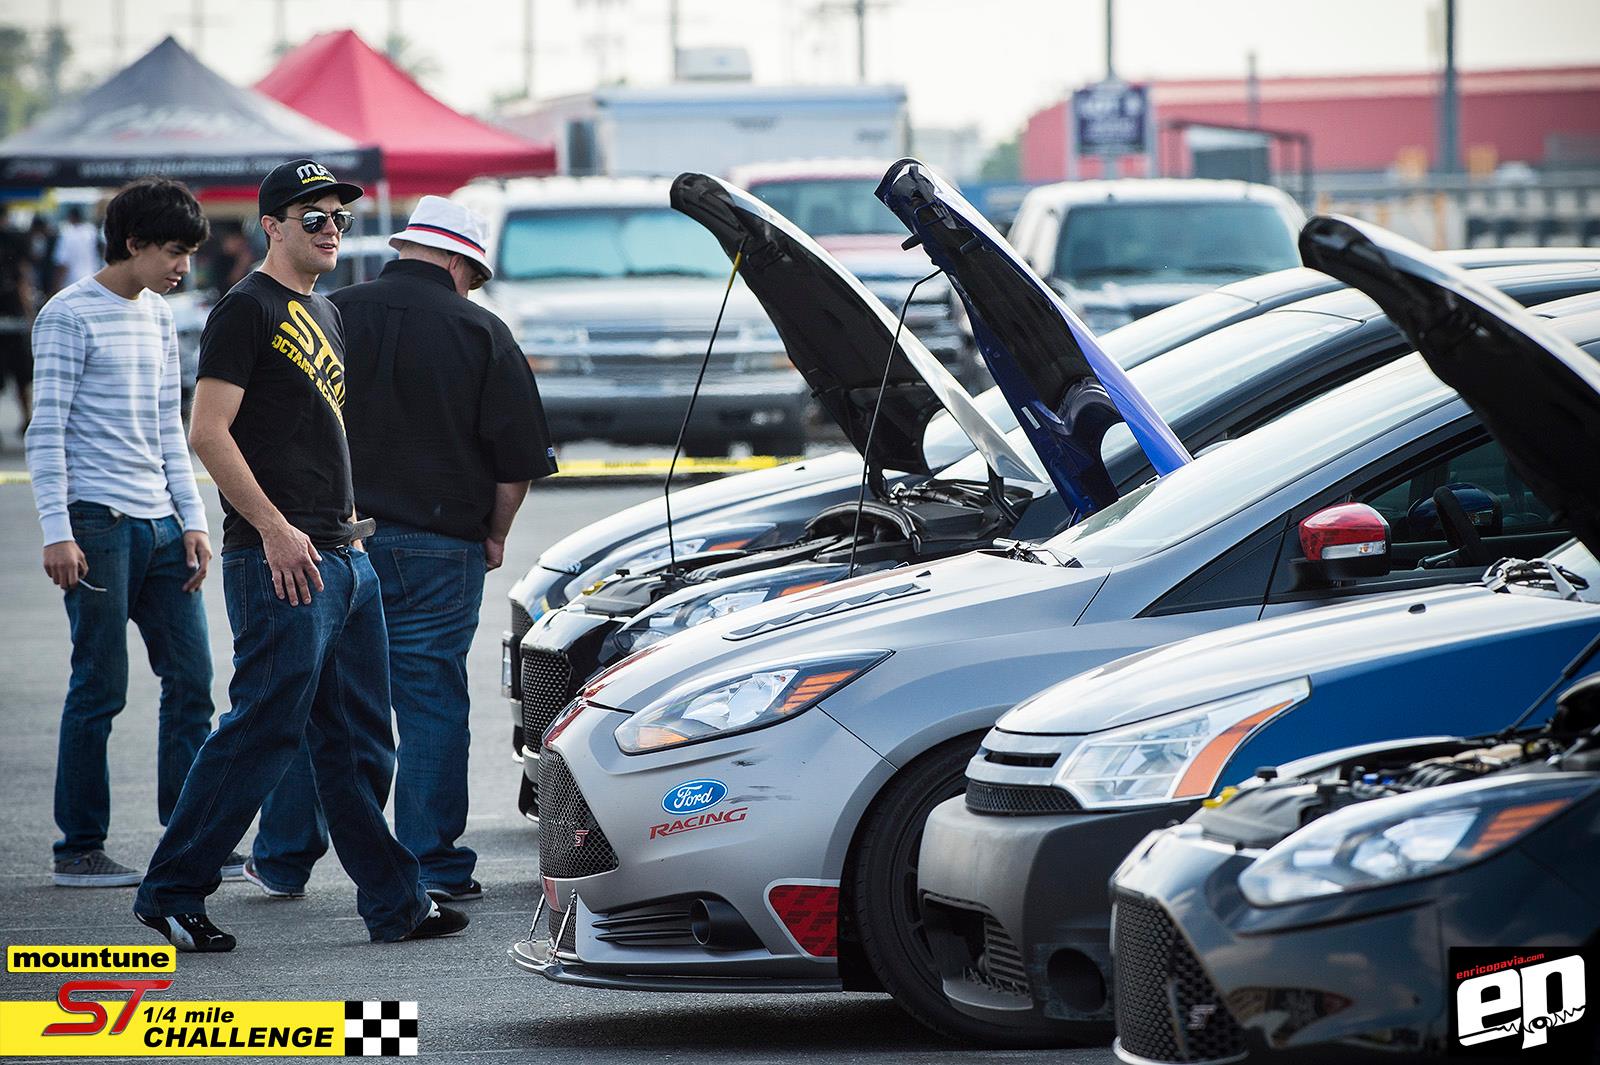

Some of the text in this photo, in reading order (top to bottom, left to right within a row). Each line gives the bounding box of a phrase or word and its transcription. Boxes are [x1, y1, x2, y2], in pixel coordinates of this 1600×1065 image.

[271, 334, 316, 381] OCTANE
[673, 784, 714, 809] Ford
[649, 807, 748, 840] RACING
